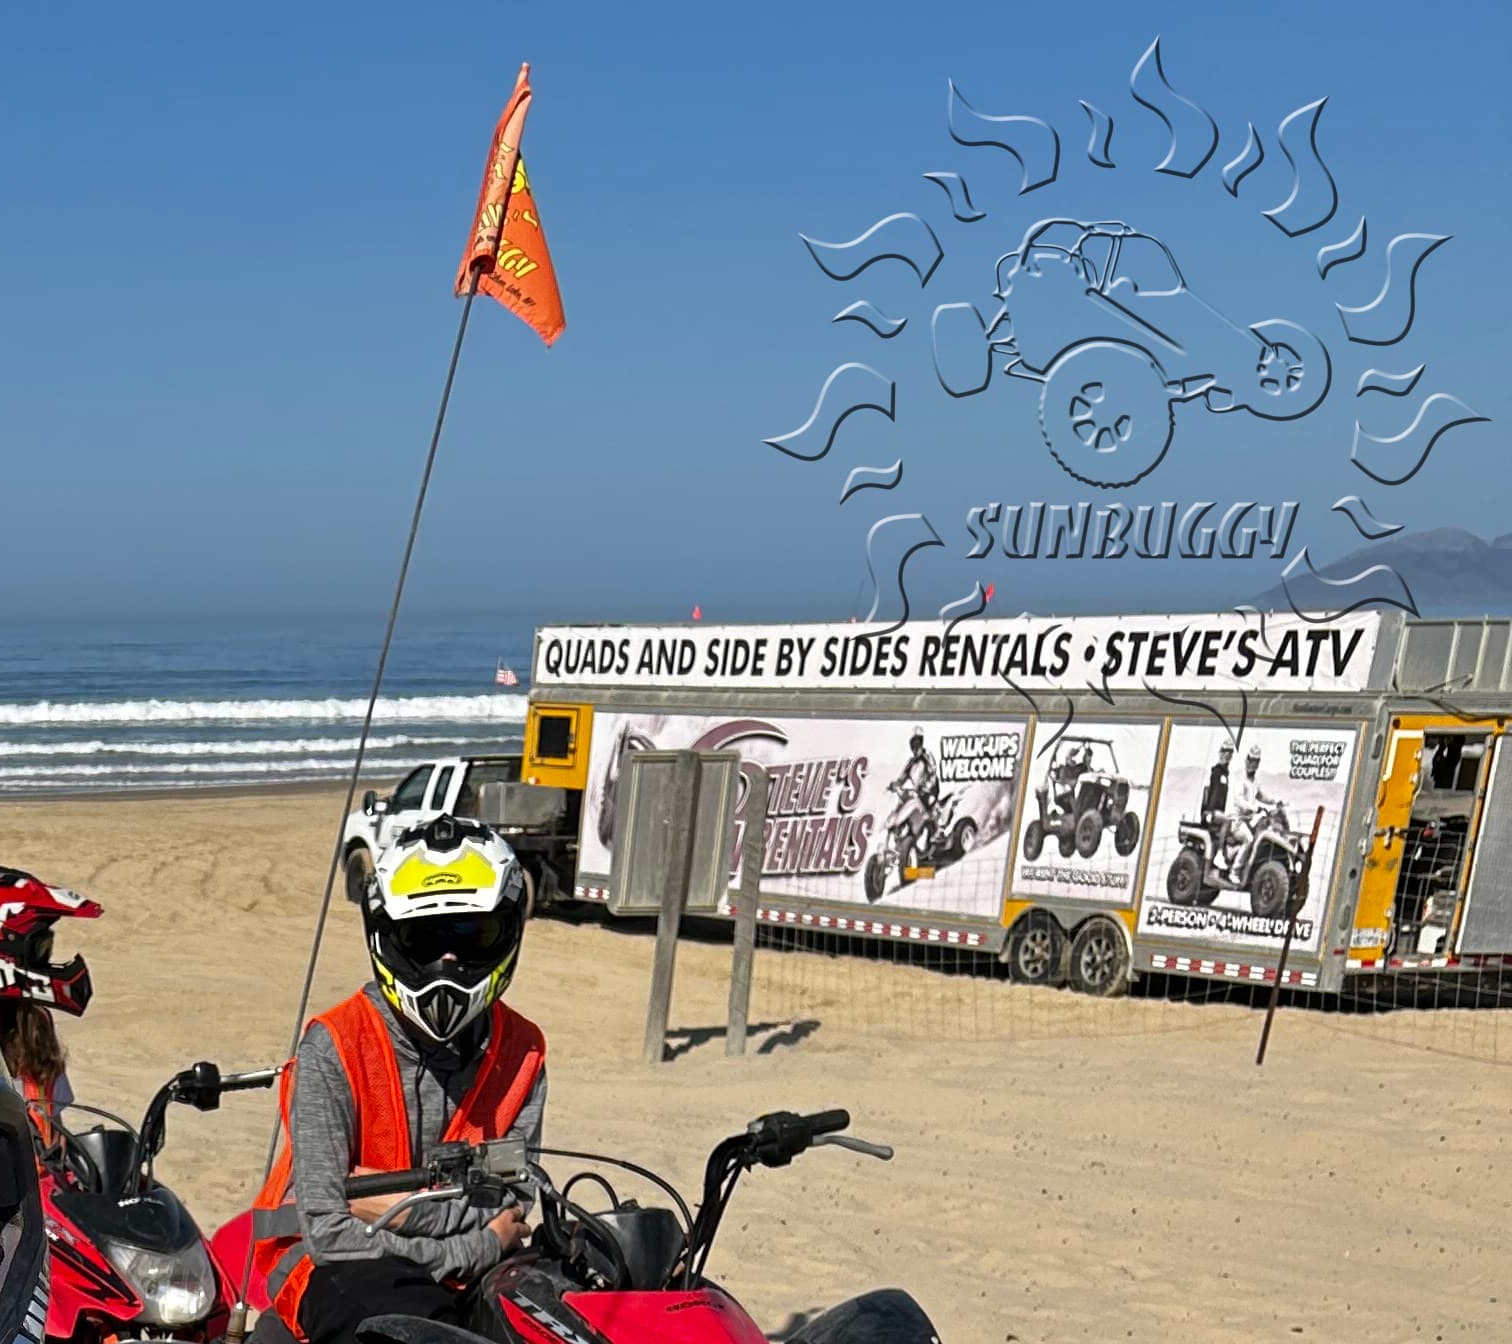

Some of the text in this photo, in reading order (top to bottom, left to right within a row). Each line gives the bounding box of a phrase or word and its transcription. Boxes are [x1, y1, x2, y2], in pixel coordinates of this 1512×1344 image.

[545, 628, 1365, 677] QUADS AND SIDE BY SIDES RENTALS STEVE'S ATV
[941, 734, 1019, 758] WALK-UPS
[941, 757, 1015, 781] WELCOME
